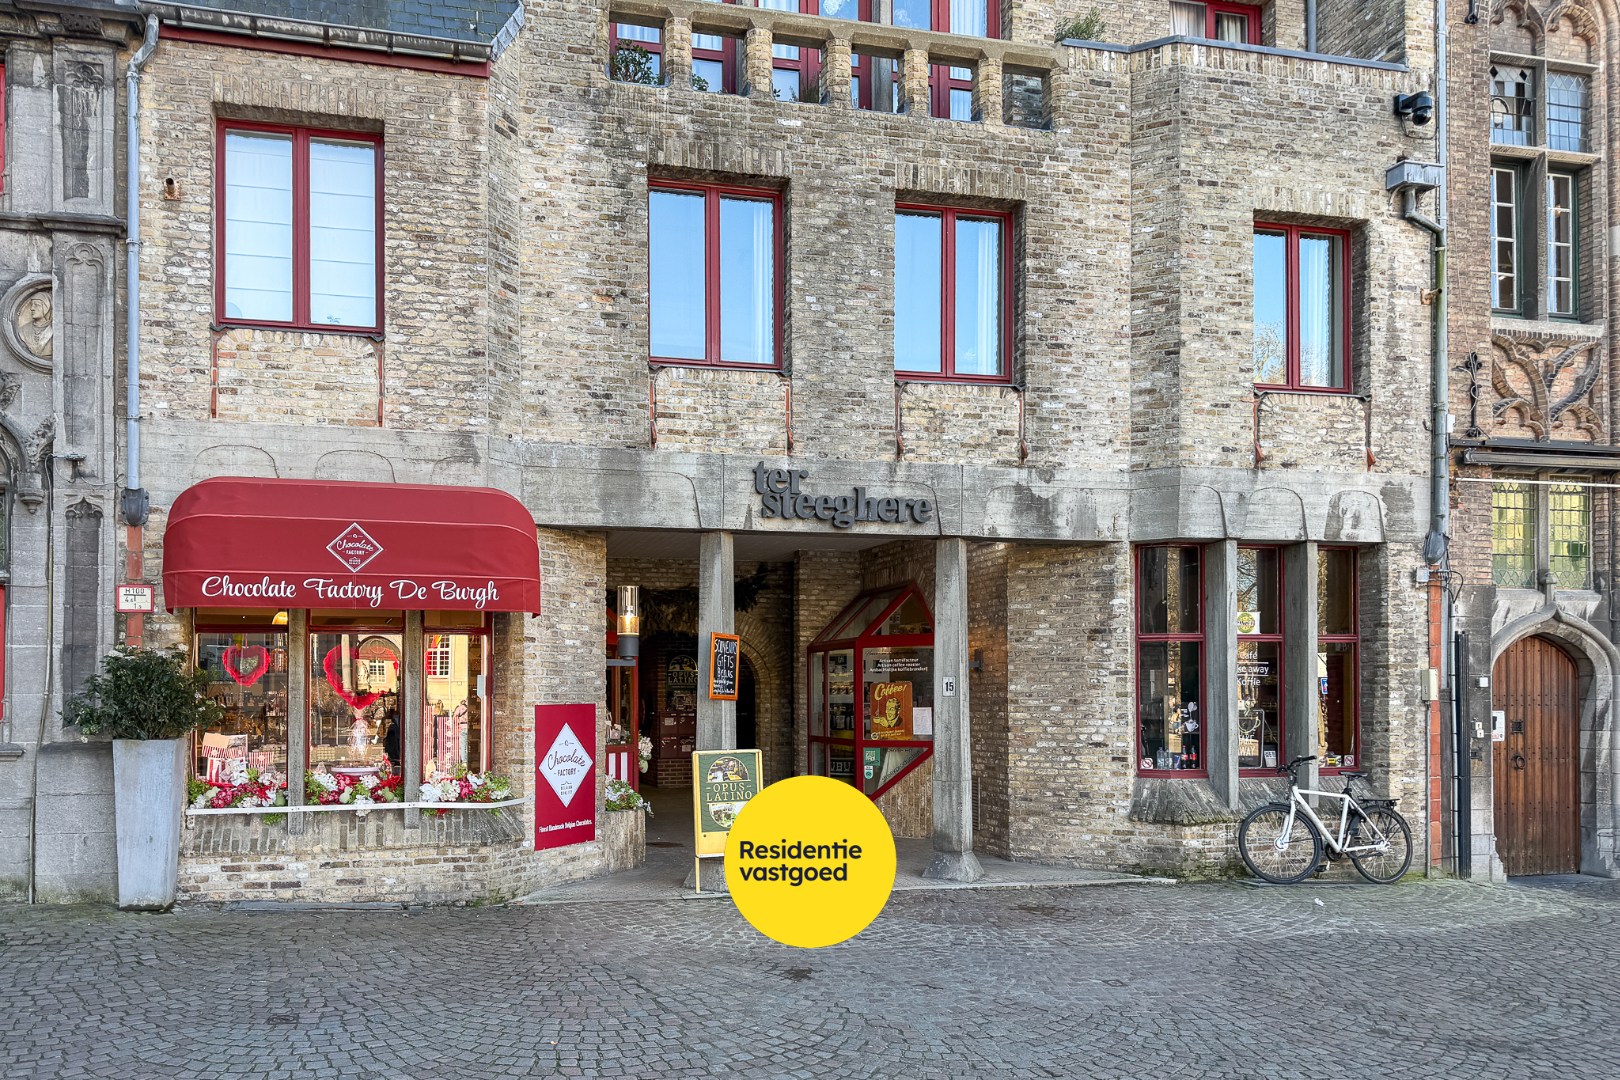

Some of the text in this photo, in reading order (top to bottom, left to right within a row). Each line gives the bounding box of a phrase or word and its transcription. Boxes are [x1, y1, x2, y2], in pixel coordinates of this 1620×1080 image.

[753, 460, 809, 494] ter
[761, 487, 933, 529] steeghere
[336, 539, 374, 551] Chocolate
[201, 575, 500, 609] Chocolate Factory De Burgh
[1240, 650, 1258, 660] Café
[1248, 665, 1269, 675] away
[945, 681, 954, 691] 15
[874, 683, 907, 701] Coffee!
[547, 748, 586, 771] Chocolate
[557, 767, 577, 777] FACTORY
[713, 782, 745, 792] OPUS
[706, 791, 752, 802] LATINO
